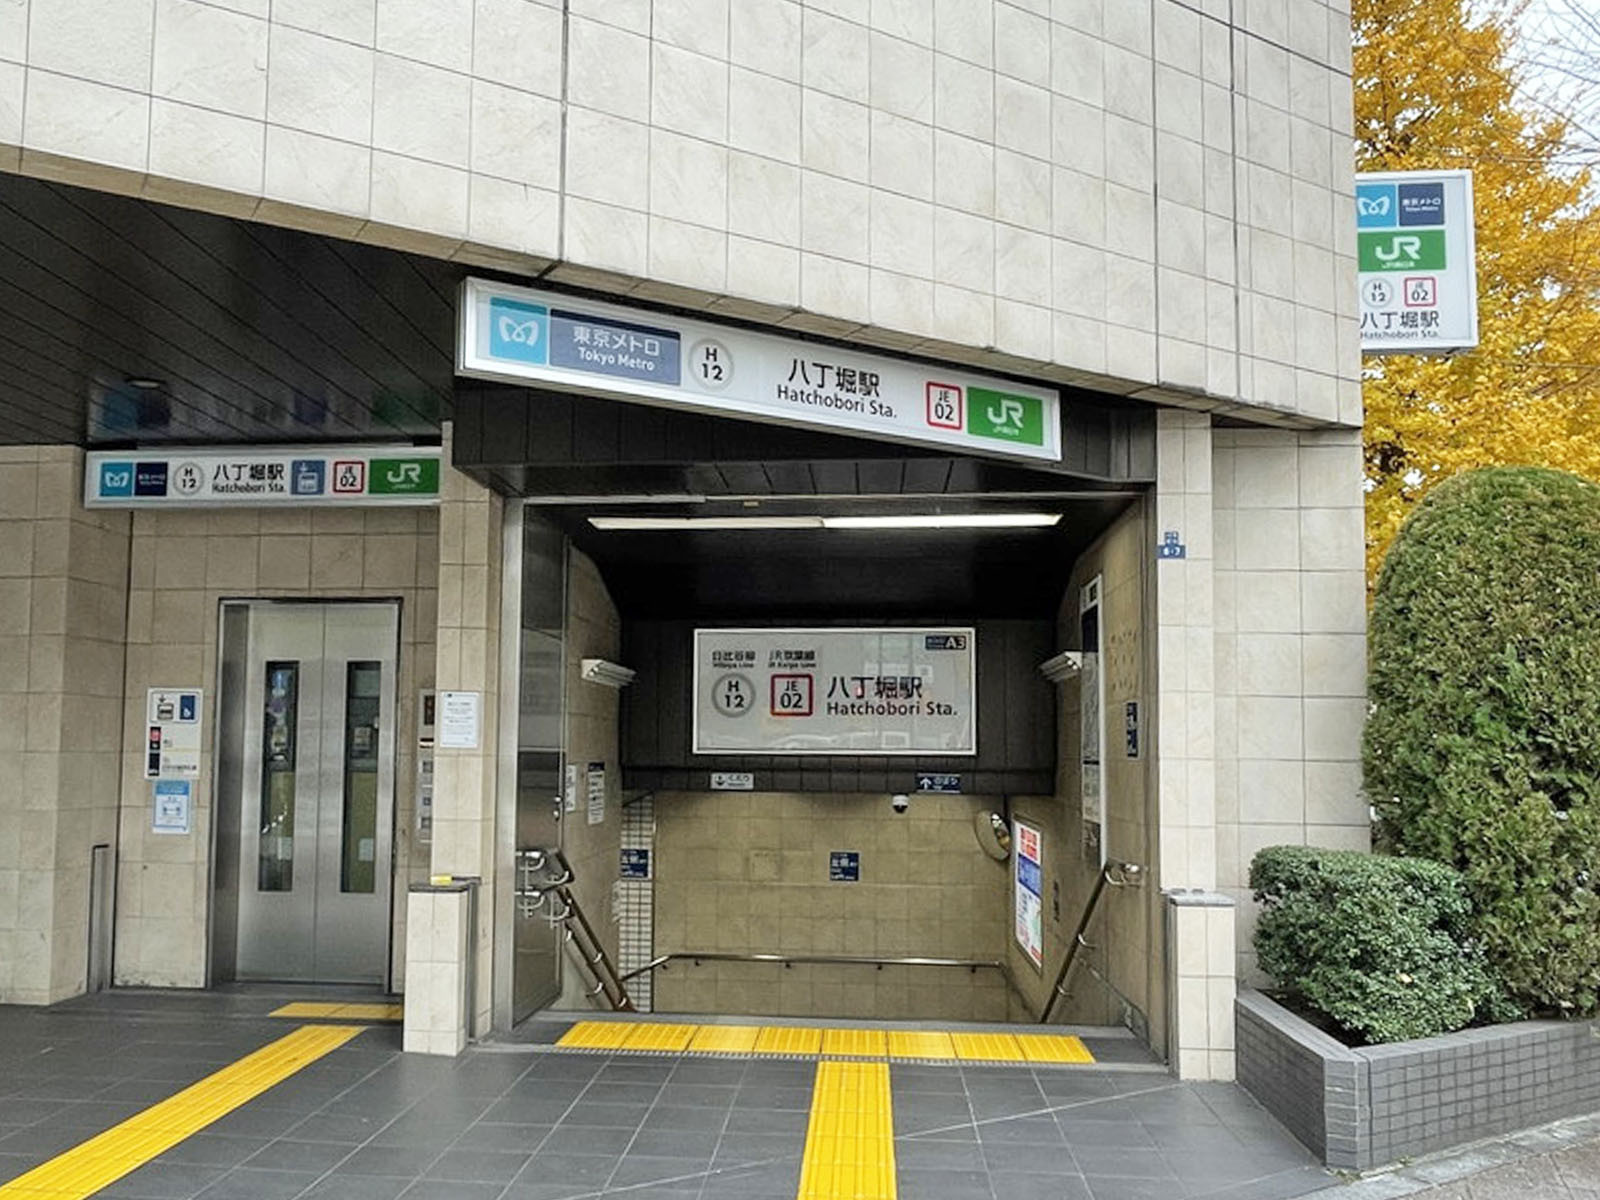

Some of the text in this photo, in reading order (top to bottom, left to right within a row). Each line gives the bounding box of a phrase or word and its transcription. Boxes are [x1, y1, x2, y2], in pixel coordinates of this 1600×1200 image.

[1375, 236, 1421, 260] JR
[1373, 283, 1382, 291] H
[1371, 293, 1386, 302] 12
[1411, 291, 1429, 301] 02
[1361, 311, 1440, 330] 八丁堀駅
[572, 325, 660, 357] 東京メトロ
[578, 347, 655, 372] Tokyo Metro
[706, 347, 718, 362] H
[701, 363, 723, 381] 12
[788, 359, 880, 398] 八丁堀駅
[777, 384, 898, 419] Hatchobori Sta.
[938, 390, 951, 403] JE
[934, 402, 954, 422] 02
[987, 399, 1024, 429] JR
[184, 468, 193, 477] H
[213, 463, 285, 481] 八丁堀駅
[387, 463, 421, 483] JR
[181, 478, 197, 488] 12
[212, 481, 265, 494] Hatchobori
[340, 475, 357, 487] 02
[945, 635, 965, 649] A3
[728, 680, 740, 692] H
[785, 680, 799, 691] JE
[827, 676, 922, 699] 八丁堀駅
[724, 694, 745, 708] 12
[780, 693, 803, 709] 02
[826, 701, 958, 716] Hatchobori Sta.
